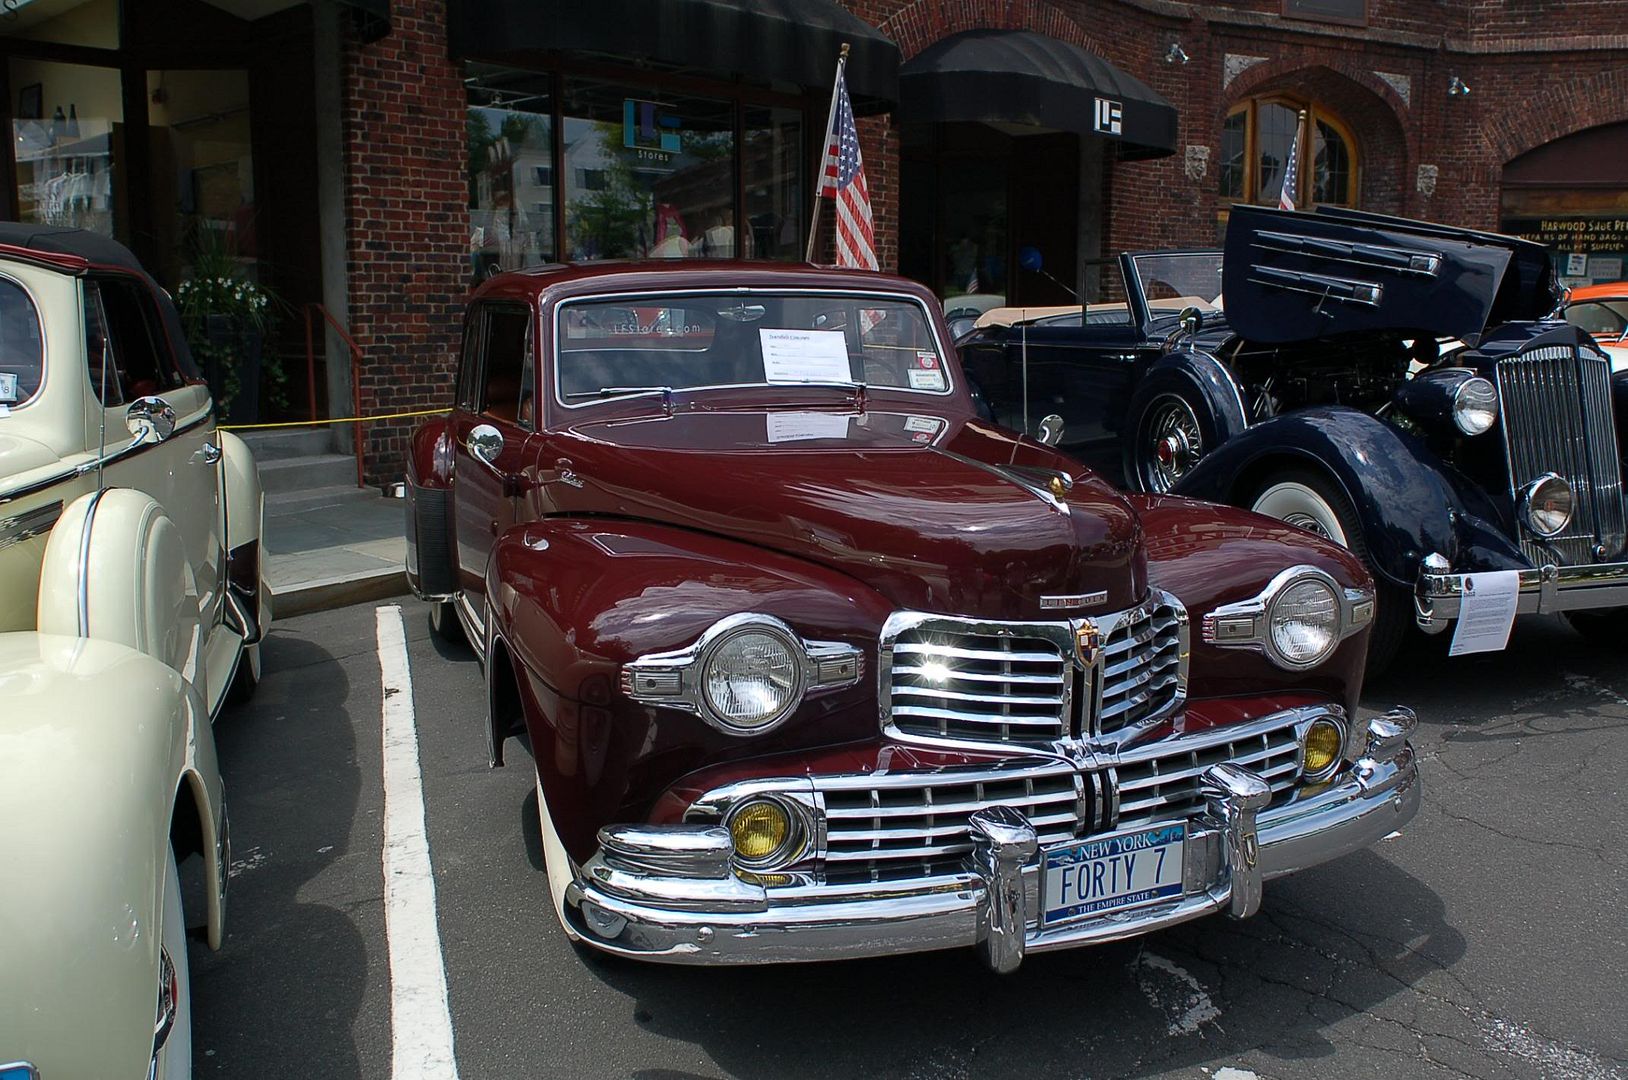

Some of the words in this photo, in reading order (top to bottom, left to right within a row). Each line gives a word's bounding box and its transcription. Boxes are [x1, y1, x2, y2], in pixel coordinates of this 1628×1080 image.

[638, 150, 669, 161] Stores
[1541, 220, 1586, 232] HARWOOD
[1079, 842, 1112, 861] NEW
[1117, 833, 1152, 852] YORK
[1061, 853, 1136, 904] FORTY
[1154, 847, 1166, 884] 7
[1078, 904, 1095, 914] THE
[1096, 897, 1126, 910] EMPIRE
[1126, 891, 1150, 903] STATE
